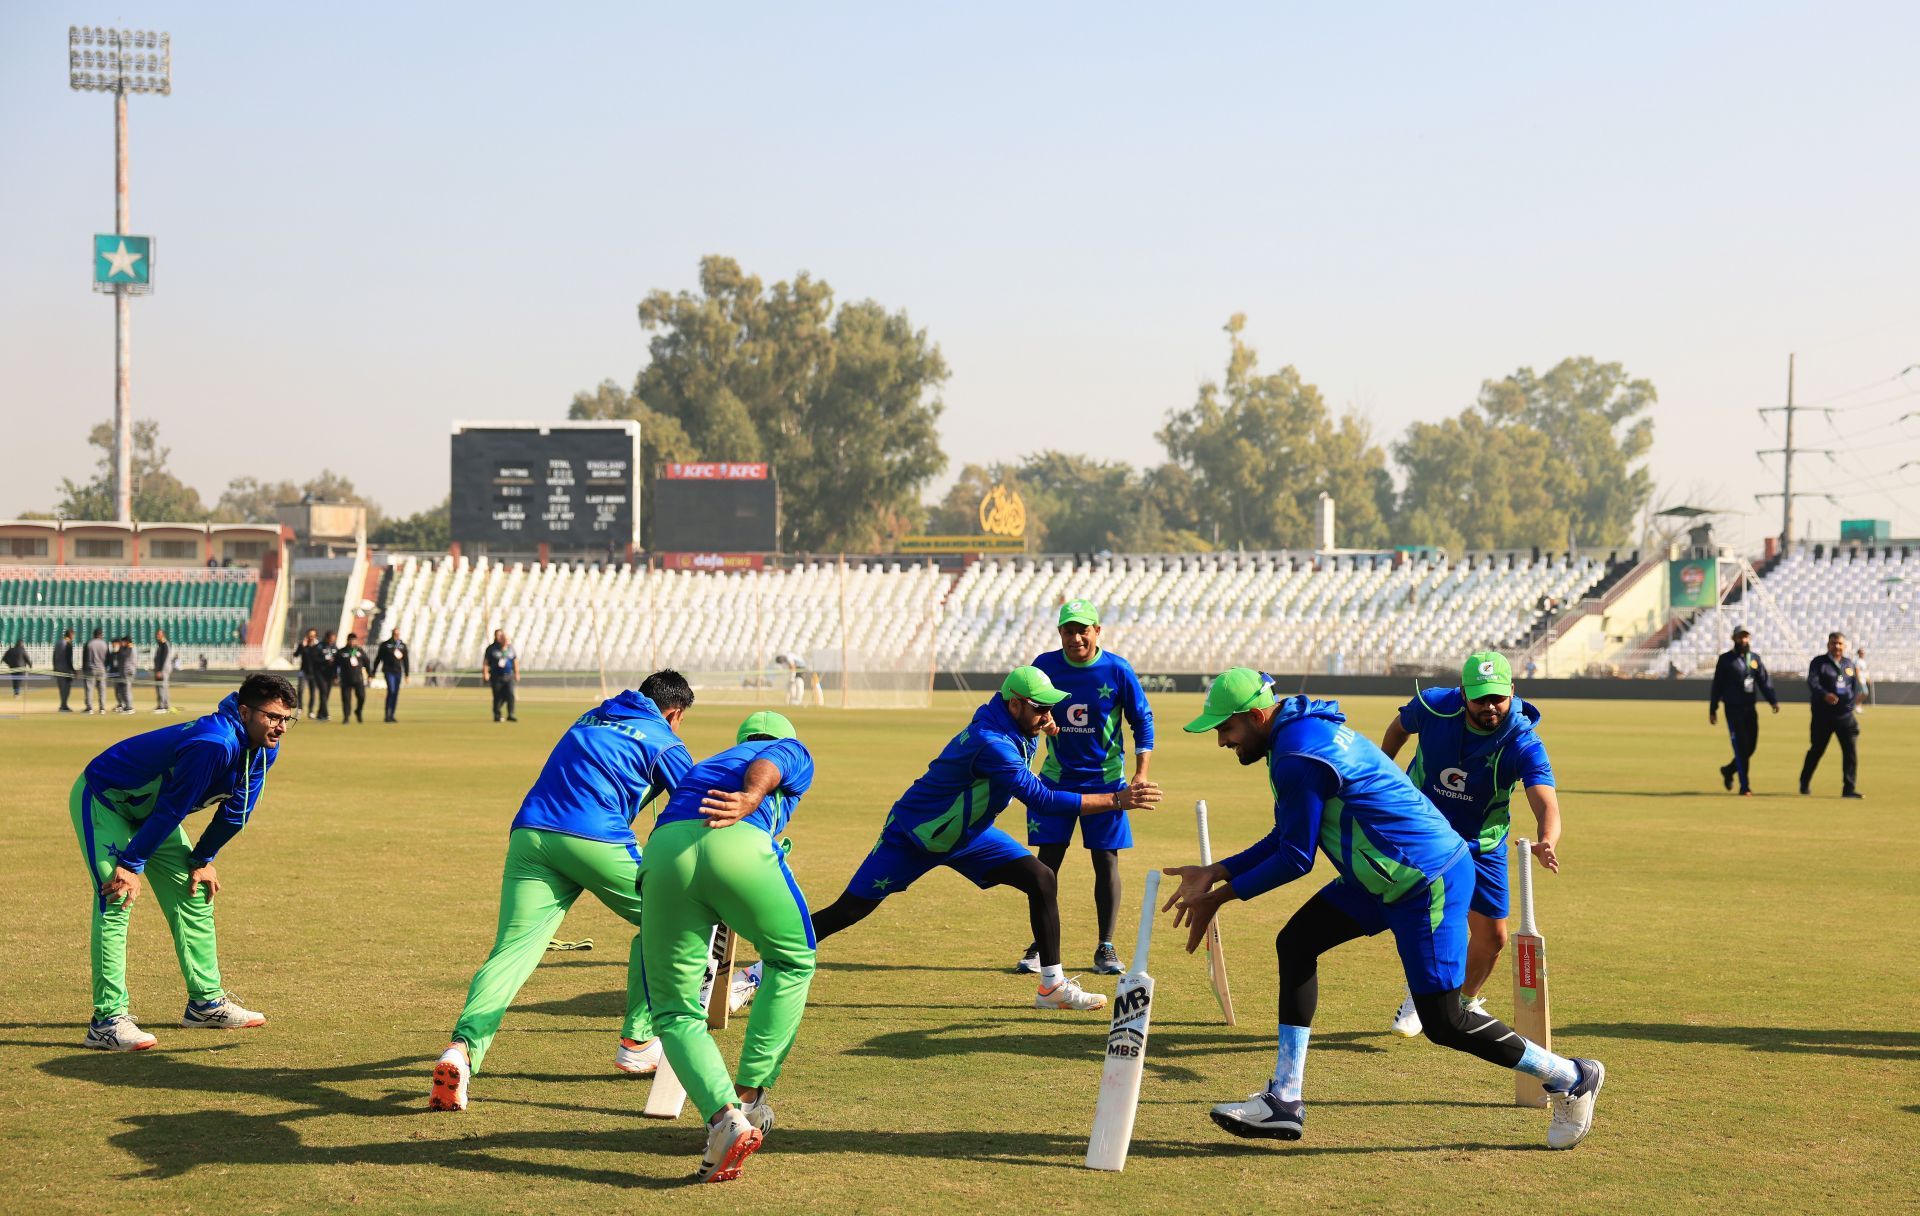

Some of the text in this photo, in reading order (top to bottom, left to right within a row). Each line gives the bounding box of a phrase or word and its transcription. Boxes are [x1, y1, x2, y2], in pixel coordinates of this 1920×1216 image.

[684, 465, 762, 477] KFC KFC
[1066, 704, 1089, 727] G
[1061, 726, 1096, 734] GATORADE
[1440, 767, 1468, 792] G
[1113, 1009, 1147, 1028] MALIK
[1108, 1044, 1140, 1057] MBS
